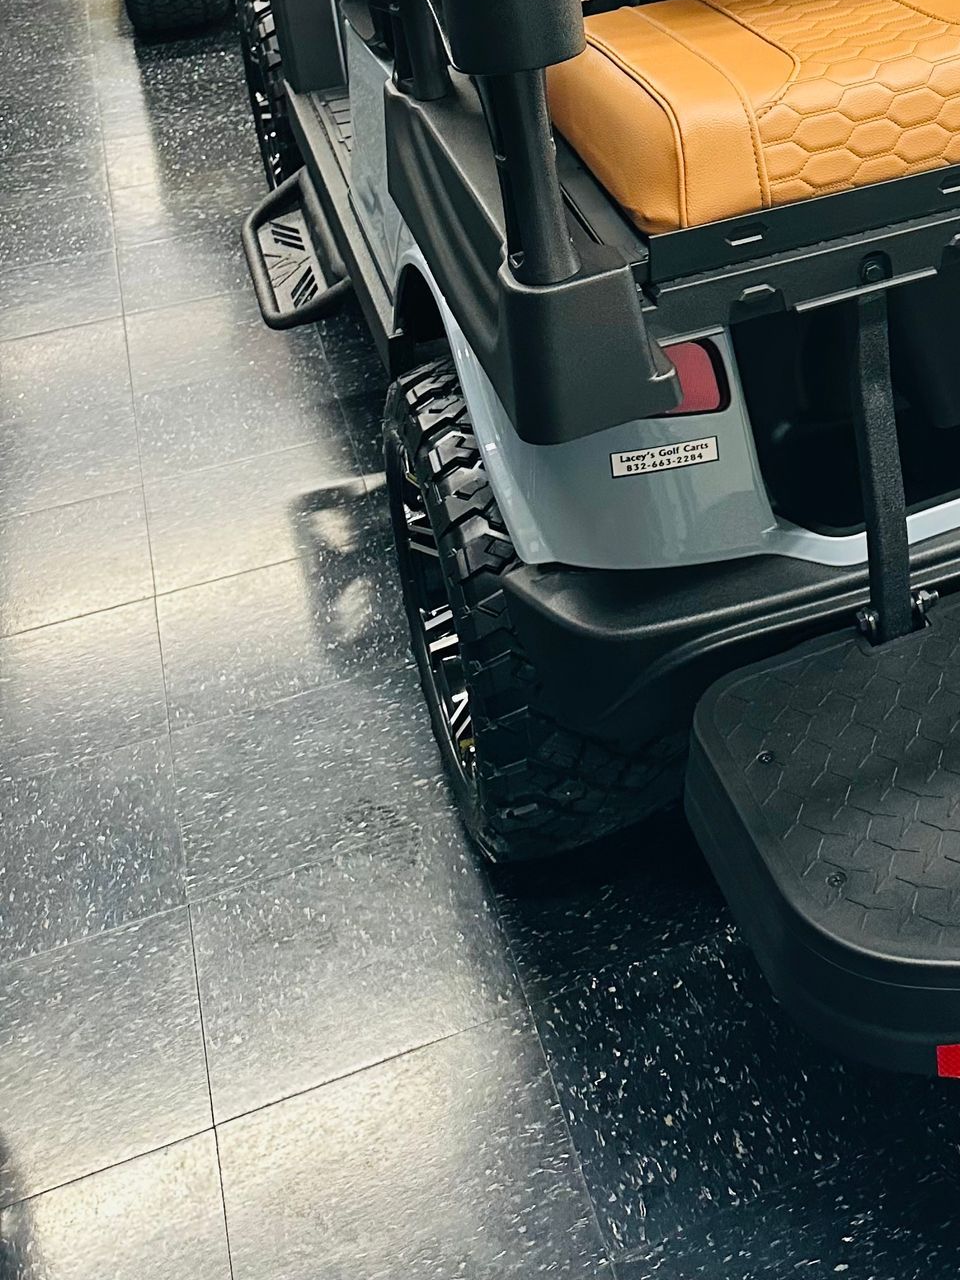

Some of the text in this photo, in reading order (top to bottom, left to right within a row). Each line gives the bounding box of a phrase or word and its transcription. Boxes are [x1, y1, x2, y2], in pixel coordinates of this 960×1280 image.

[619, 442, 708, 463] Lacey's Golf Carts
[626, 452, 703, 472] 832-663-2284
